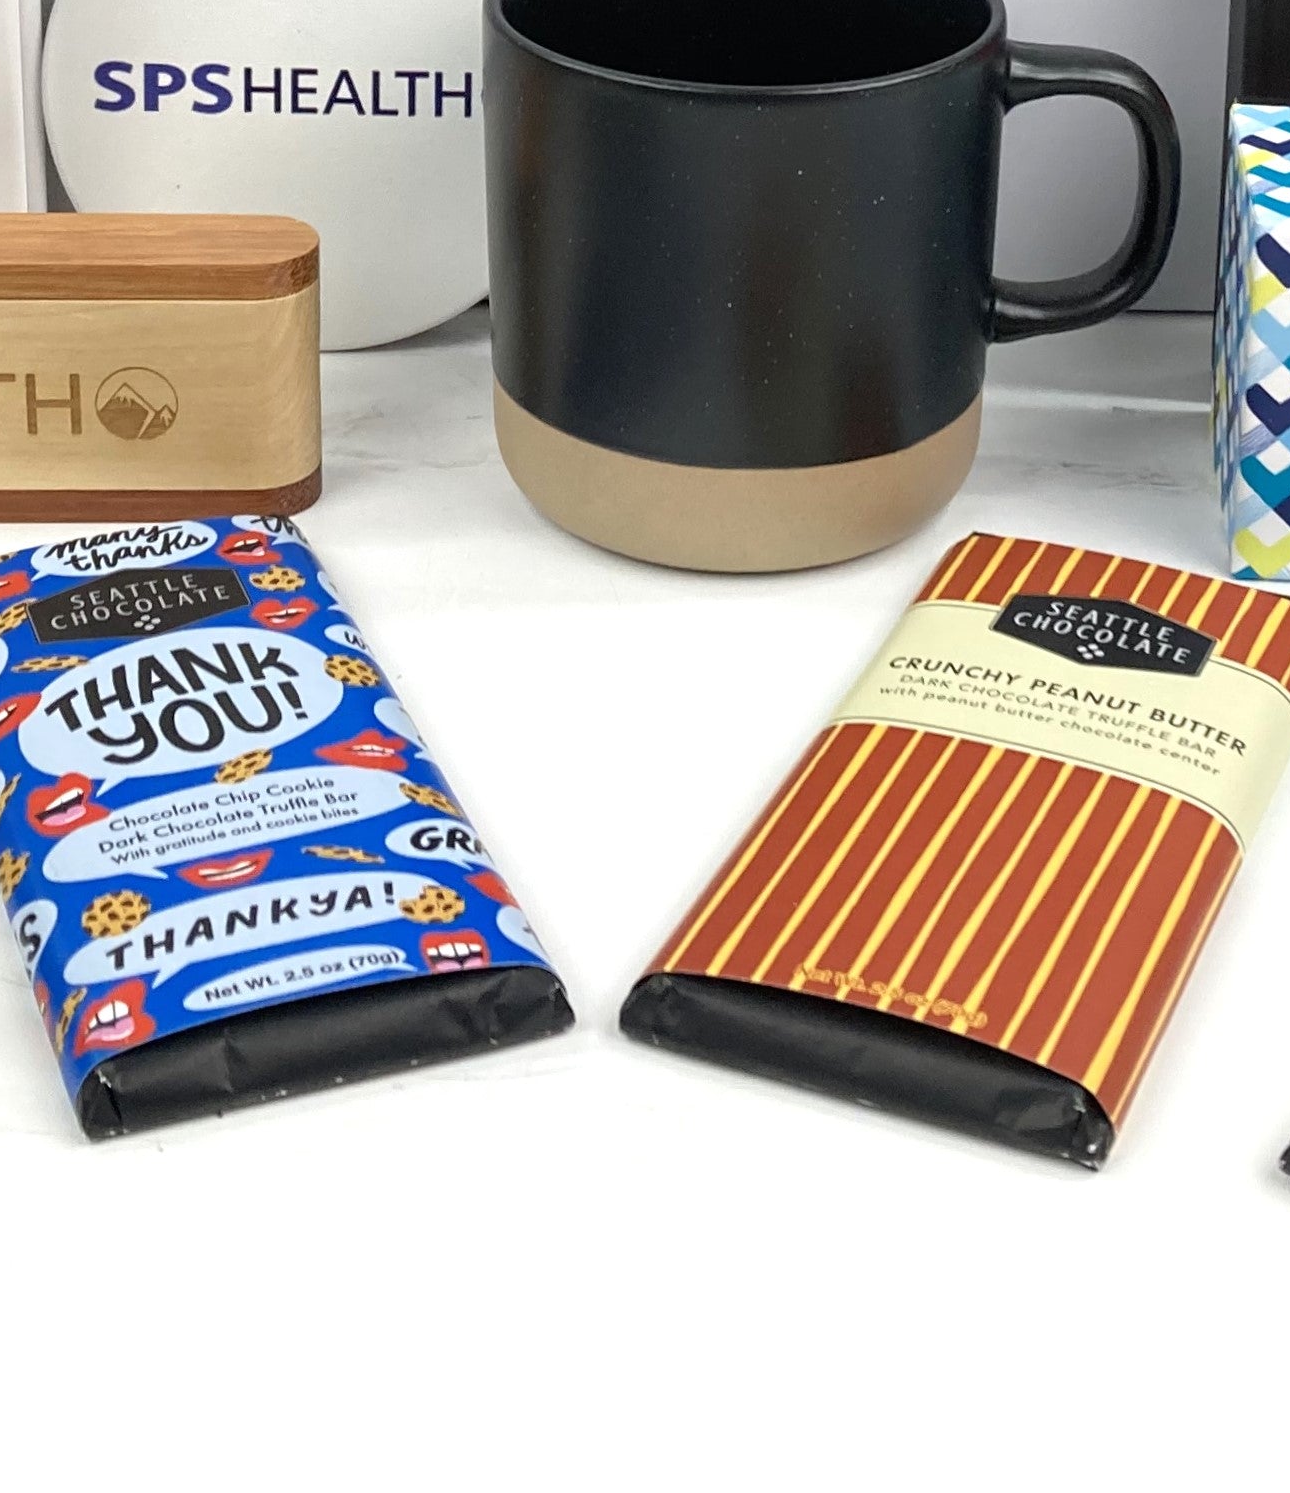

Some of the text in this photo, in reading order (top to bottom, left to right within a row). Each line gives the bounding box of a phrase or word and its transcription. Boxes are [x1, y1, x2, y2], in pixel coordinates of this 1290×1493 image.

[44, 522, 183, 559] many
[63, 530, 209, 572] thanks
[50, 584, 232, 632] CHOCOLATE
[70, 574, 199, 610] SEATTLE
[1012, 610, 1192, 666] CHOCOLATE
[1045, 601, 1176, 644] SEATTLE
[43, 642, 301, 734] THANK
[888, 656, 1248, 758] CRUNCHY PEANUT BUTTER
[898, 673, 1218, 760] DARK CHOCOLATE TRUFFLE BAR
[87, 681, 310, 766] YOU!
[878, 684, 1221, 777] with peanut butter chocolate center
[98, 791, 359, 855] Dark Chocolate Truffle Bar
[108, 776, 335, 833] Chocolate Chip Cookie
[110, 806, 360, 866] With gratitude and cookie bites
[204, 981, 243, 1004] Net
[284, 964, 316, 983] 2.5
[319, 961, 346, 975] oz
[348, 949, 401, 973] (70g)
